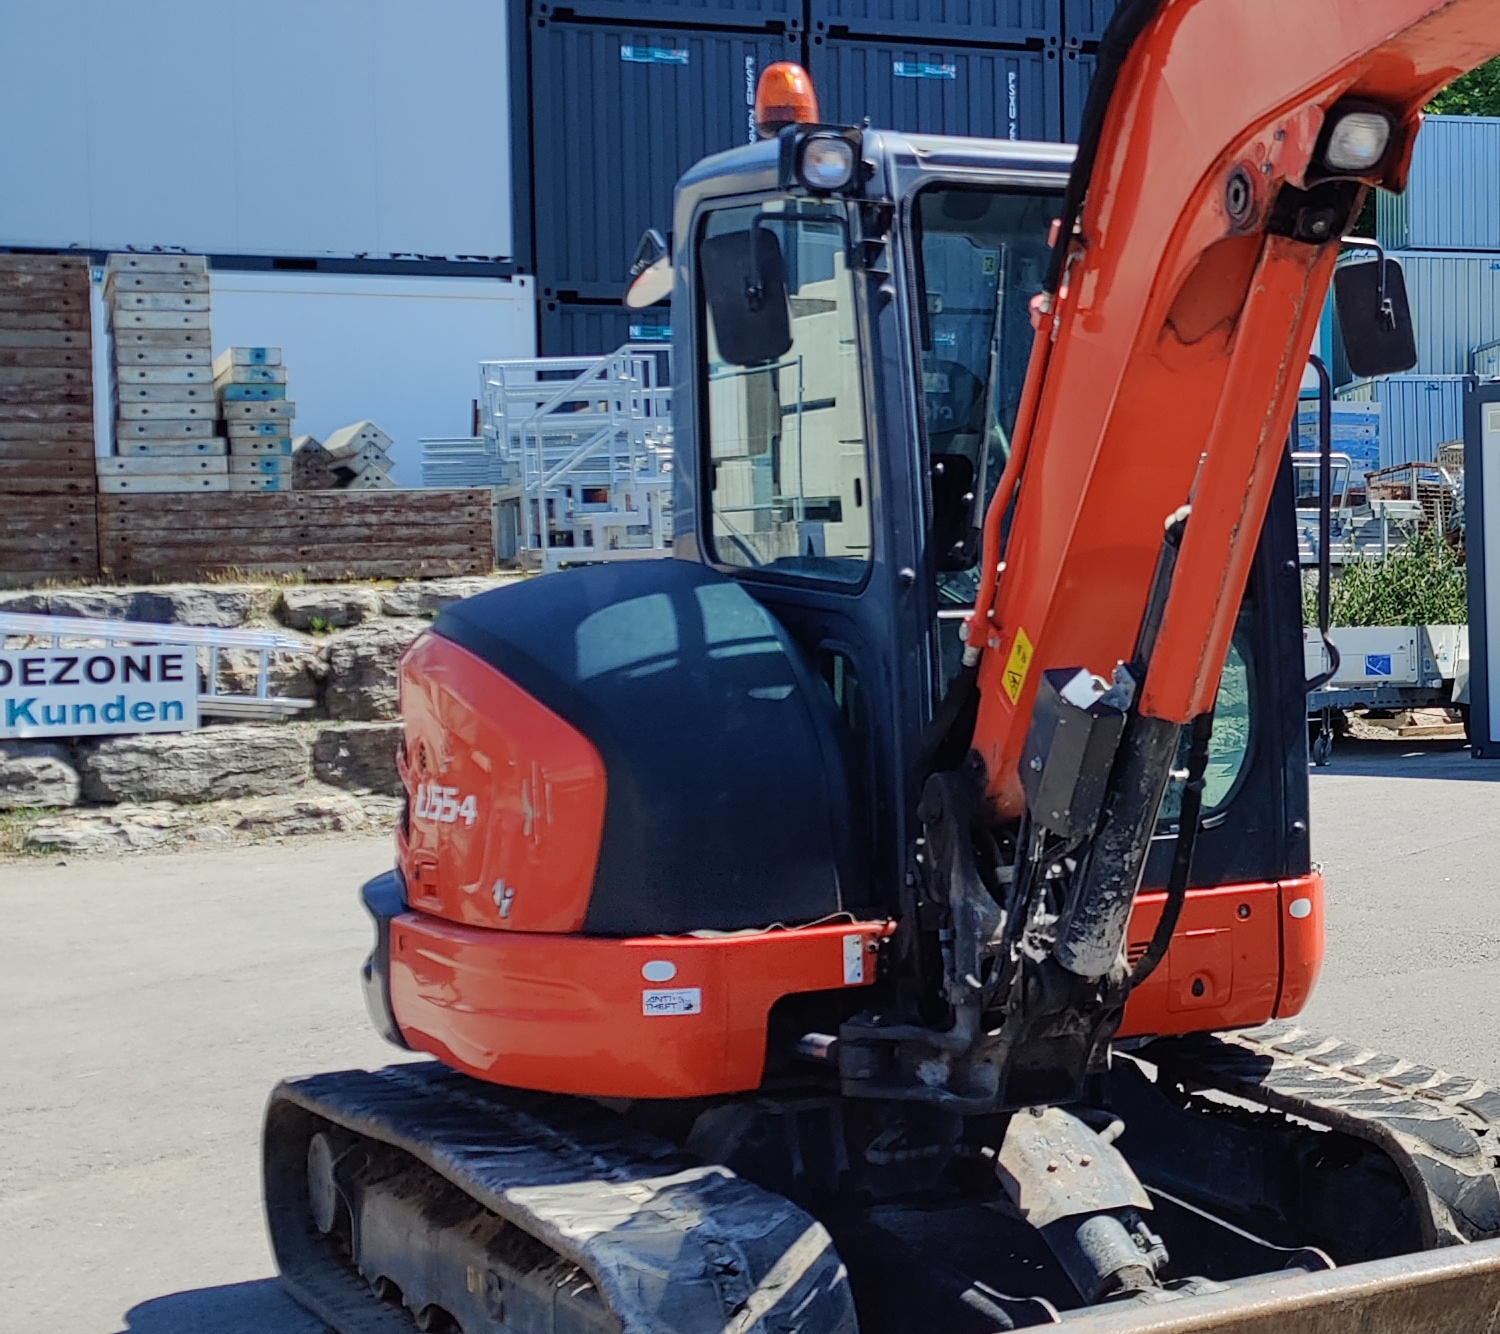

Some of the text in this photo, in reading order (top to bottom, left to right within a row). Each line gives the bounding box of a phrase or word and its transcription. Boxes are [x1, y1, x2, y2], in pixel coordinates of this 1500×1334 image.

[745, 56, 756, 106] PSXU
[1008, 71, 1017, 120] PSXU
[5, 694, 184, 727] Kunden
